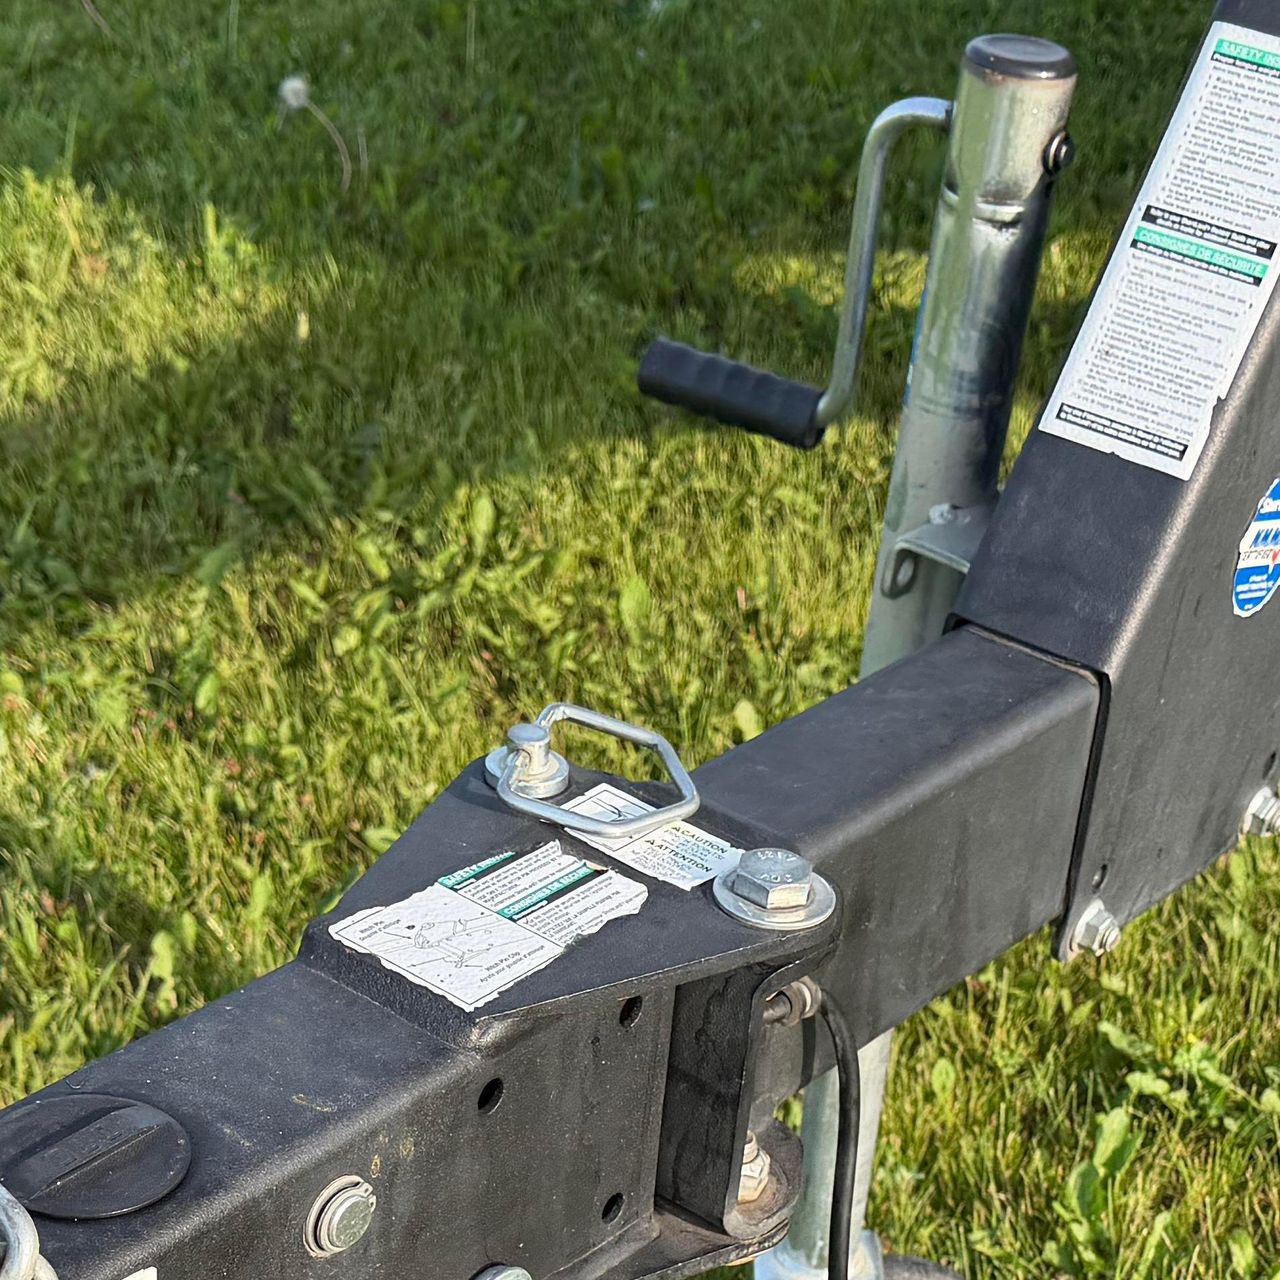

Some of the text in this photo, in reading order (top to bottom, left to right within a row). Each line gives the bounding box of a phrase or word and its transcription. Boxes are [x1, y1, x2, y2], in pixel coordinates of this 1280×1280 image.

[1221, 40, 1264, 60] SAFETY
[681, 830, 728, 854] CAUTION
[656, 844, 713, 873] ATTENTION
